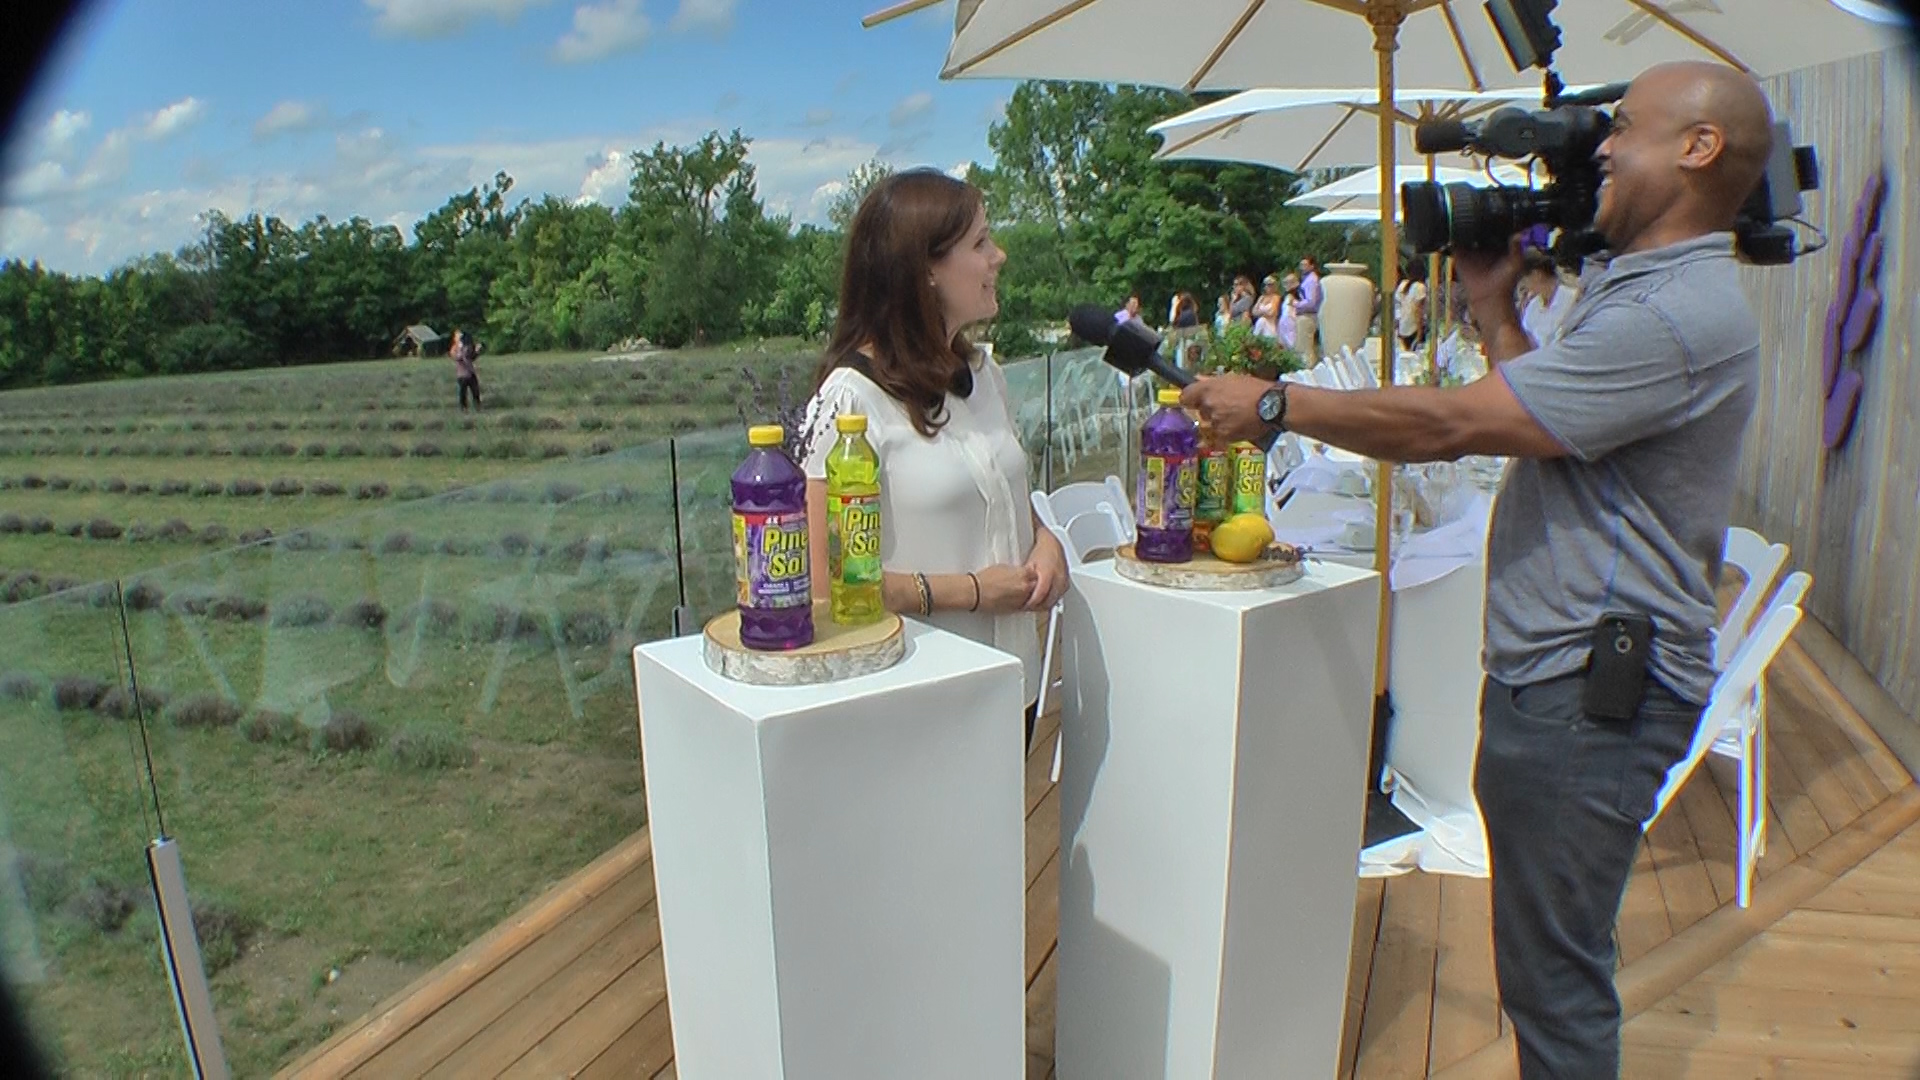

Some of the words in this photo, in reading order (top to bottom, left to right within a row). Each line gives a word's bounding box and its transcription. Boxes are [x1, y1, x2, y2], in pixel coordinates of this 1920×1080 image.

[1239, 458, 1264, 475] Pin
[847, 508, 880, 531] Pin
[763, 528, 807, 553] Pine
[853, 532, 880, 554] So
[771, 553, 804, 577] Sol
